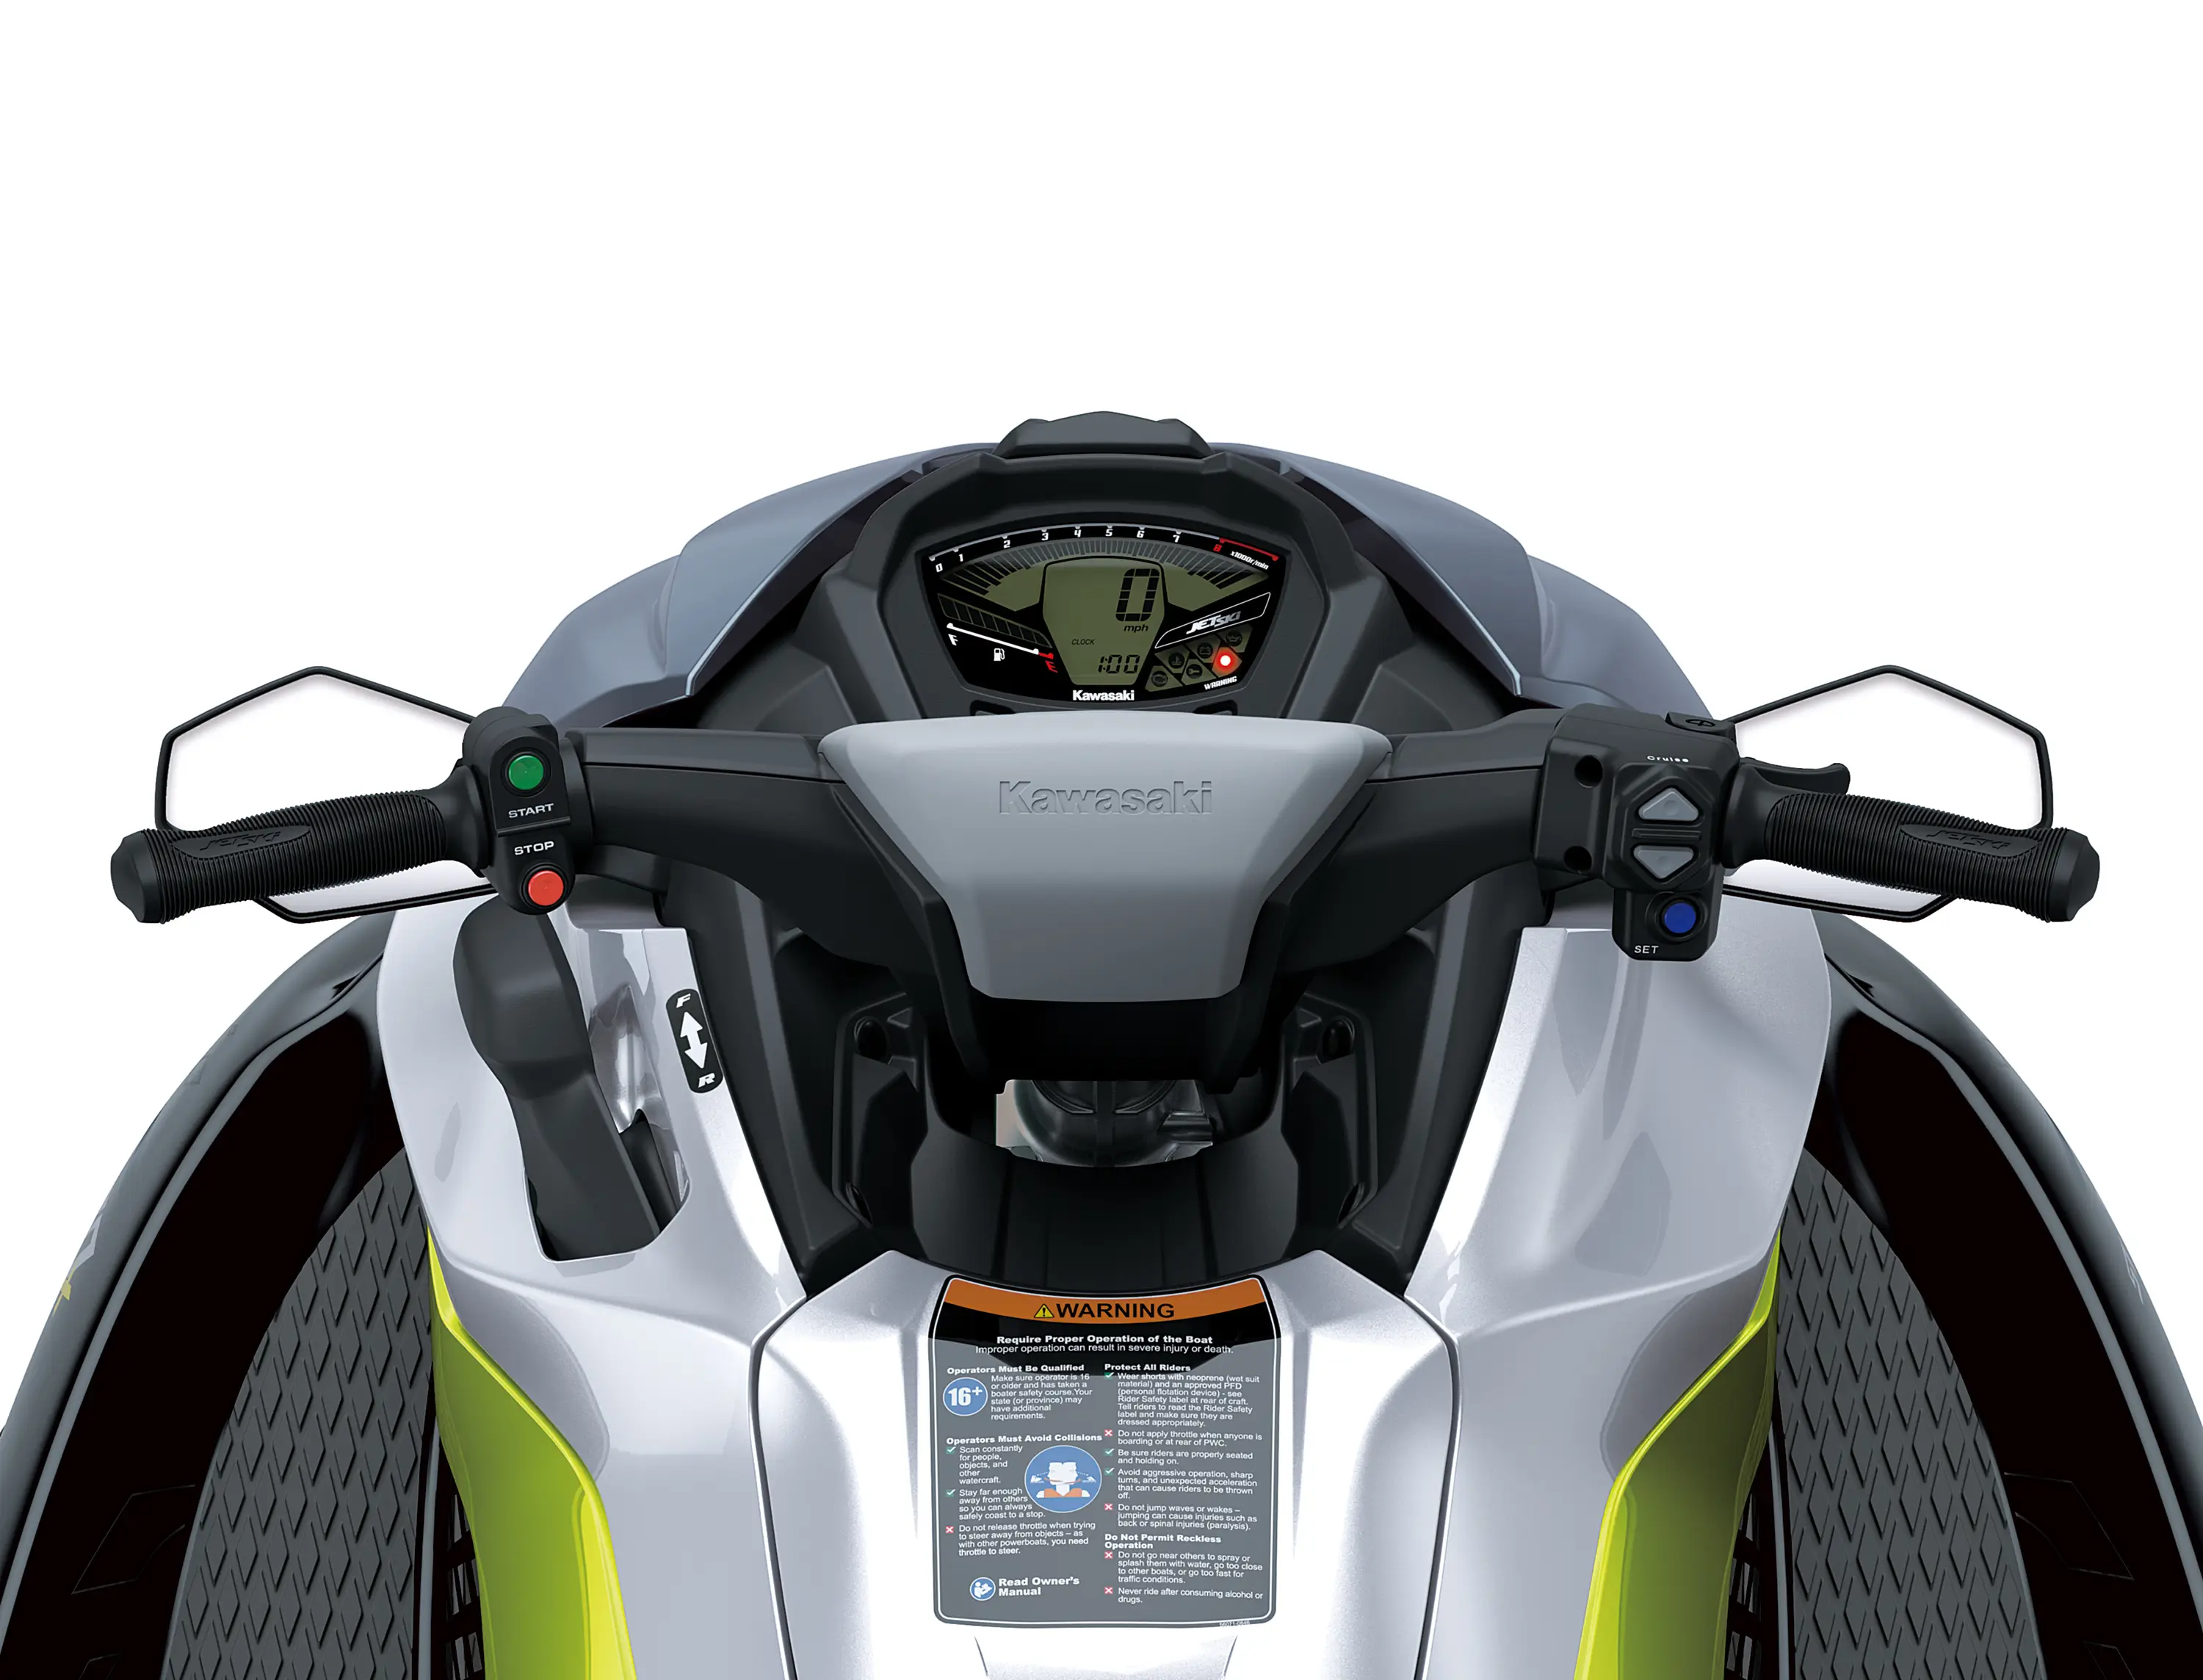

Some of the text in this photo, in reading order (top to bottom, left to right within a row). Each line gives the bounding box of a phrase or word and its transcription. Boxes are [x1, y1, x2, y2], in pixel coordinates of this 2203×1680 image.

[1042, 532, 1049, 541] 3
[1074, 529, 1081, 537] 4
[1137, 530, 1145, 538] 6
[1173, 535, 1180, 543] 7
[1003, 540, 1010, 548] 2
[959, 554, 963, 562] 1
[936, 563, 943, 572] 0
[1115, 568, 1160, 621] 0
[948, 634, 958, 645] F
[1045, 660, 1058, 673] E
[1098, 654, 1140, 673] 1:00
[1204, 676, 1237, 689] WARNING
[1073, 690, 1135, 700] Kawasaki
[999, 781, 1212, 815] Kawasaki
[508, 803, 554, 818] START
[514, 841, 554, 855] STOP
[1634, 945, 1659, 954] SET
[676, 993, 691, 1008] F
[698, 1072, 715, 1087] R
[1057, 1303, 1175, 1318] WARNING
[996, 1336, 1041, 1344] Require
[1045, 1336, 1084, 1344] Proper
[1087, 1336, 1144, 1344] Operation
[1185, 1336, 1212, 1344] Boat
[975, 1345, 1019, 1355] Improper
[1021, 1344, 1065, 1354] operation
[1088, 1343, 1115, 1352] result
[1118, 1344, 1126, 1352] in
[1163, 1344, 1189, 1354] injury
[1206, 1344, 1234, 1353] death.
[947, 1366, 996, 1375] Operators
[1041, 1364, 1085, 1372] Qualified
[1035, 1373, 1068, 1382] operator
[1226, 1375, 1243, 1383] (wet
[1118, 1380, 1153, 1389] material)
[1184, 1382, 1221, 1390] approved
[948, 1386, 983, 1406] 16+
[1019, 1389, 1043, 1398] safety
[1013, 1397, 1024, 1405] (or
[1026, 1397, 1063, 1405] province)
[991, 1412, 1046, 1421] requirements.
[1151, 1419, 1205, 1427] appropriately.
[1146, 1431, 1168, 1439] apply
[946, 1437, 995, 1445] Operators
[983, 1445, 1023, 1453] constantly
[972, 1454, 1002, 1462] people,
[1191, 1451, 1224, 1460] properly
[959, 1461, 991, 1470] objects,
[1135, 1458, 1165, 1466] holding
[1188, 1471, 1229, 1479] operation,
[1230, 1471, 1254, 1480] sharp
[1118, 1477, 1140, 1485] turns,
[1160, 1478, 1207, 1486] unexpected
[959, 1489, 977, 1497] Stay
[993, 1488, 1022, 1496] enough
[1073, 1522, 1096, 1531] trying
[1000, 1539, 1049, 1548] powerboats,
[959, 1548, 986, 1556] throttle
[999, 1576, 1079, 1586] Read Owner's
[999, 1587, 1041, 1596] Manual
[1180, 1590, 1223, 1599] consuming
[1118, 1596, 1143, 1604] drugs.
